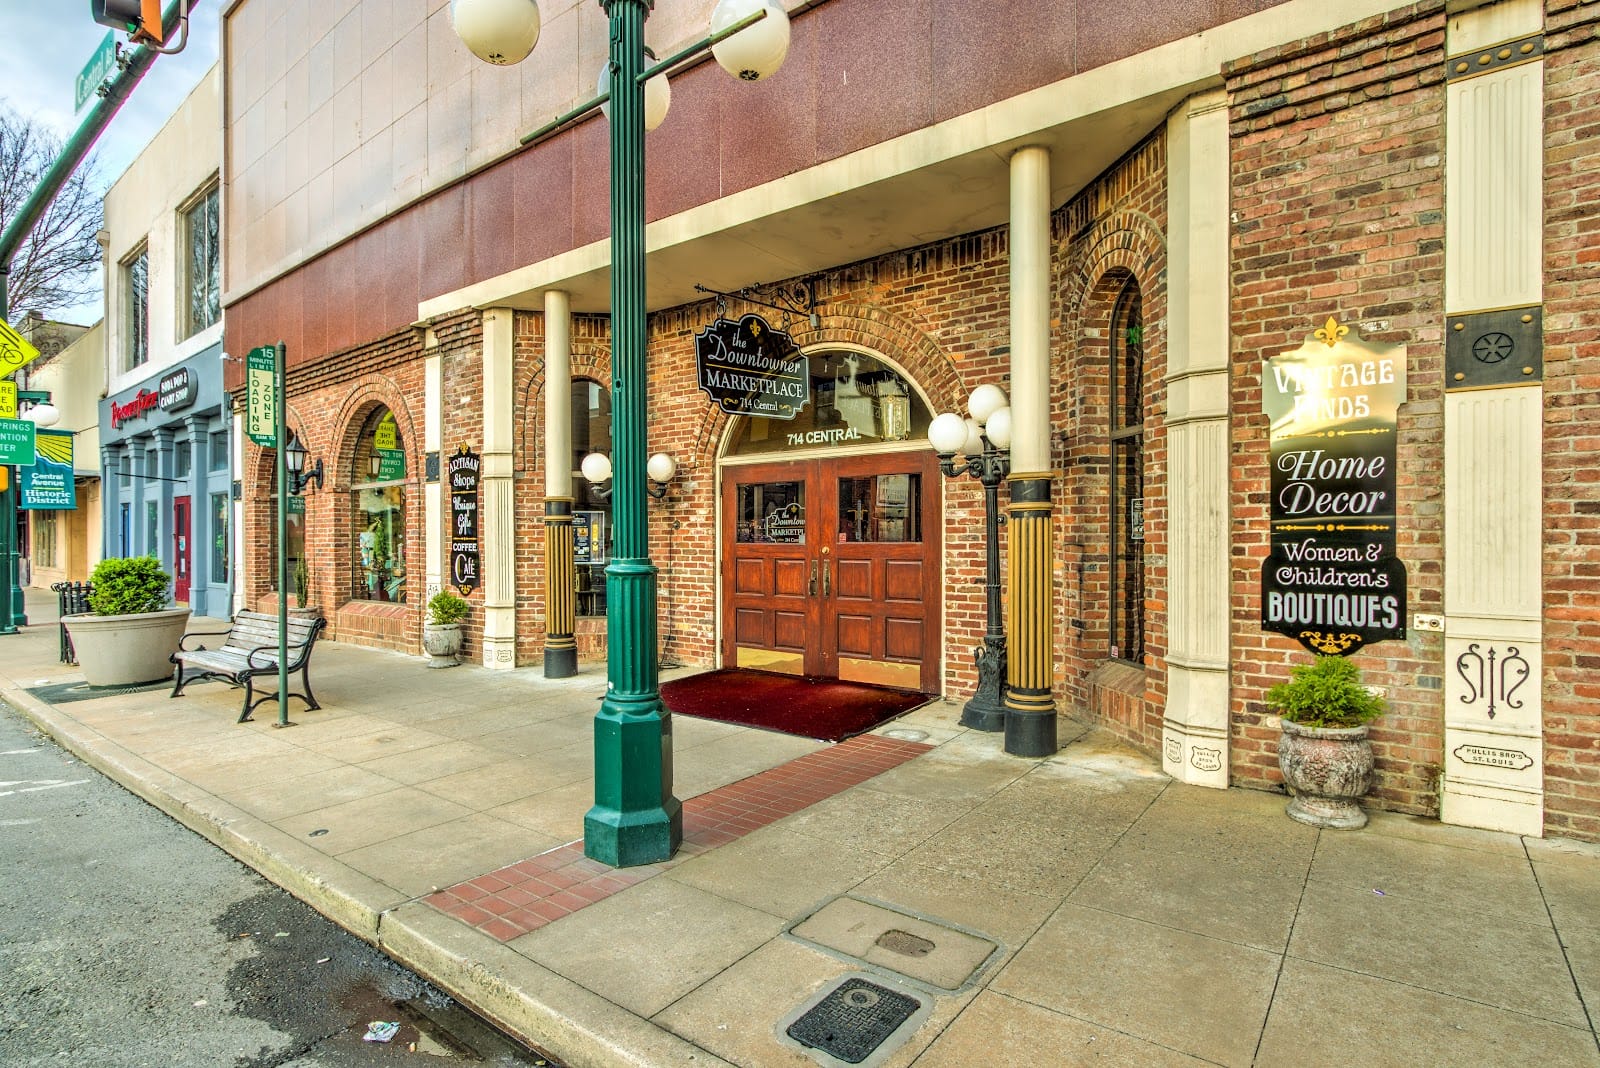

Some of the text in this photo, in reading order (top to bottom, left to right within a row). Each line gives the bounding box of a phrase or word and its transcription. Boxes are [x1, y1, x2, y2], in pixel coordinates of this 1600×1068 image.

[732, 327, 747, 349] the
[249, 357, 274, 365] MINUTE
[260, 348, 274, 359] 15
[707, 333, 801, 374] Downtowner
[249, 363, 274, 371] LIMIT
[706, 368, 804, 398] MARKETPLACE
[252, 370, 272, 432] LOADING ZONE
[739, 397, 778, 411] 714 Central
[787, 427, 861, 446] 714 CENTRAL
[449, 456, 480, 473] ARTISAN
[1277, 450, 1385, 481] Home
[31, 472, 64, 480] Central
[31, 479, 65, 487] Avenue
[453, 473, 475, 490] Shops
[25, 489, 71, 498] Historic
[1279, 482, 1386, 514] Decor
[452, 496, 476, 516] Unique
[457, 513, 472, 535] Gifts
[452, 542, 477, 552] COFFEE
[1281, 538, 1382, 562] Women &
[1275, 566, 1389, 588] Children's
[1268, 591, 1399, 629] BOUTIQUES
[1486, 757, 1514, 766] LOUIS
